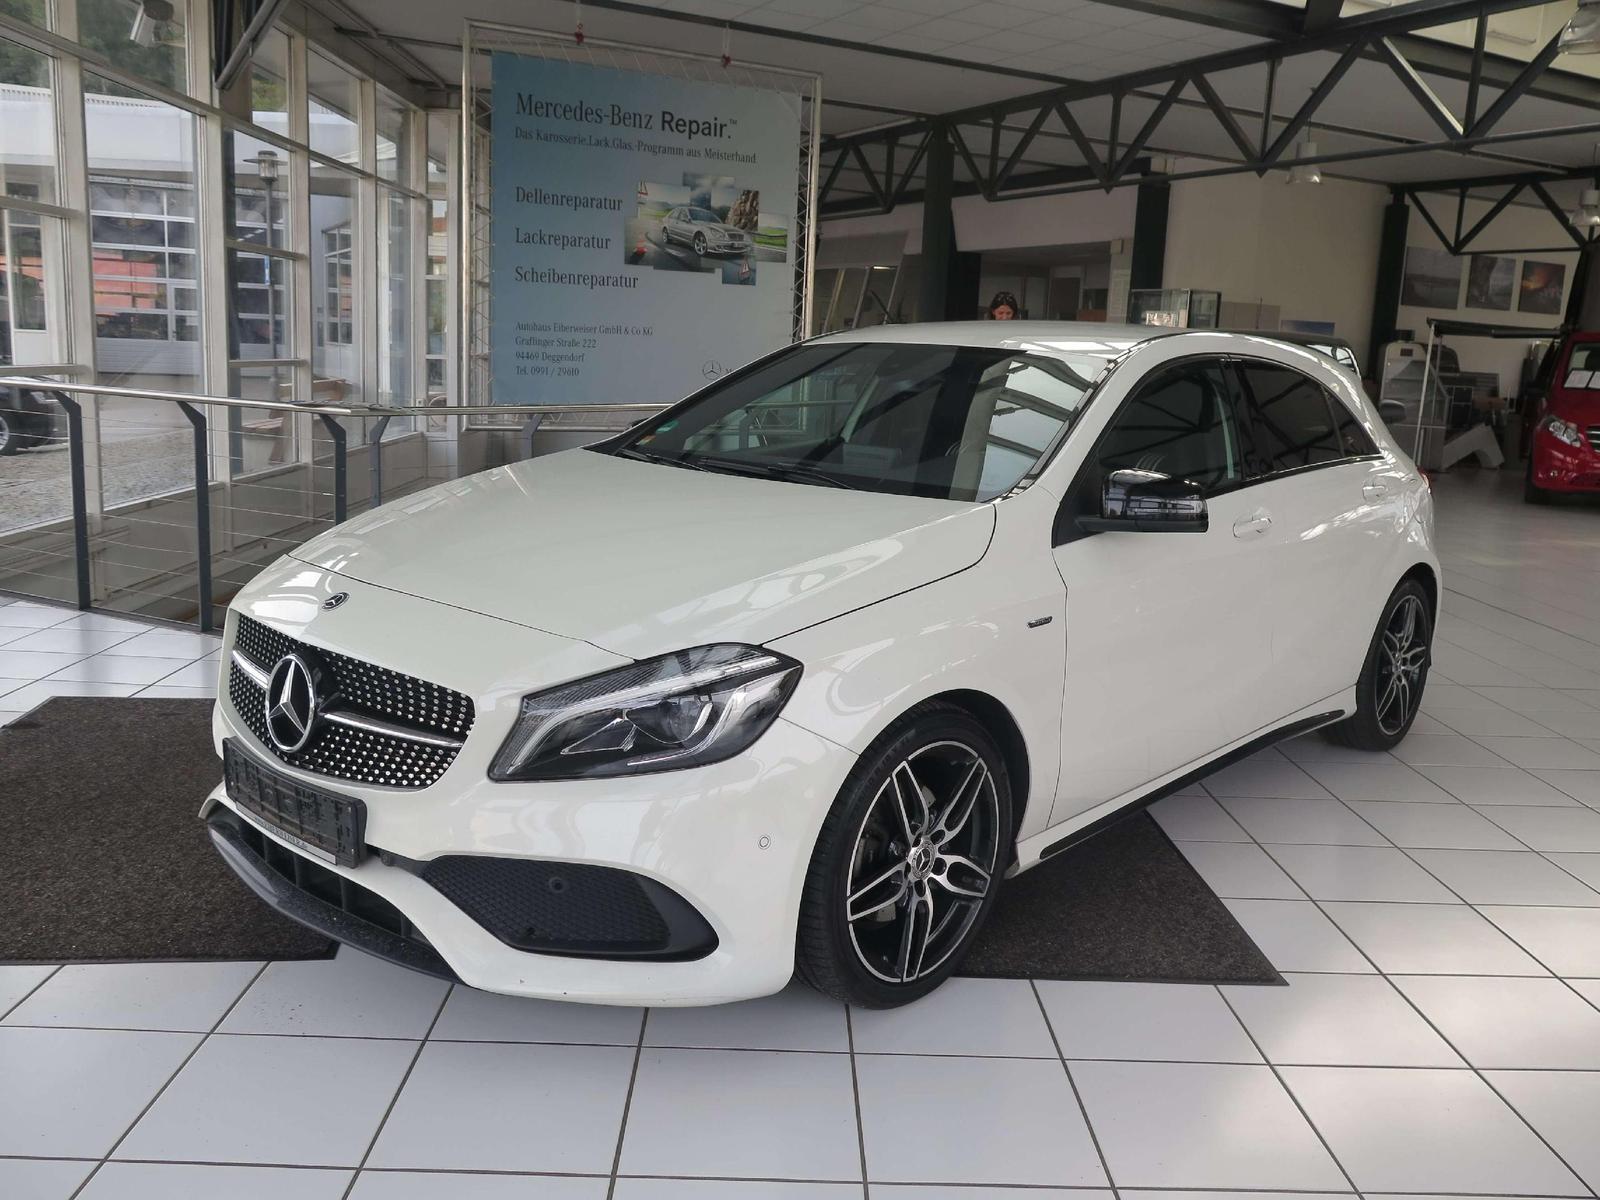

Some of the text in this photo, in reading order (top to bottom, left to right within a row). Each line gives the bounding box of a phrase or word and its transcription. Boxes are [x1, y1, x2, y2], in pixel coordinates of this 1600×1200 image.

[516, 92, 653, 129] Mercedes-Benz
[515, 126, 533, 141] Das
[686, 147, 701, 158] aus
[515, 186, 623, 212] Dellenreparatur
[515, 228, 611, 250] Lackreparatur
[515, 266, 639, 289] Scheibenreparatur
[515, 322, 551, 333] Autohaus
[599, 324, 622, 335] GmbH
[623, 326, 629, 336] &
[631, 326, 641, 336] Co
[642, 326, 653, 337] KG
[557, 337, 581, 348] Straße
[582, 339, 597, 349] 222
[515, 351, 585, 364] 94469 Deggendorf
[516, 365, 529, 376] Tel.
[530, 366, 549, 376] 0991
